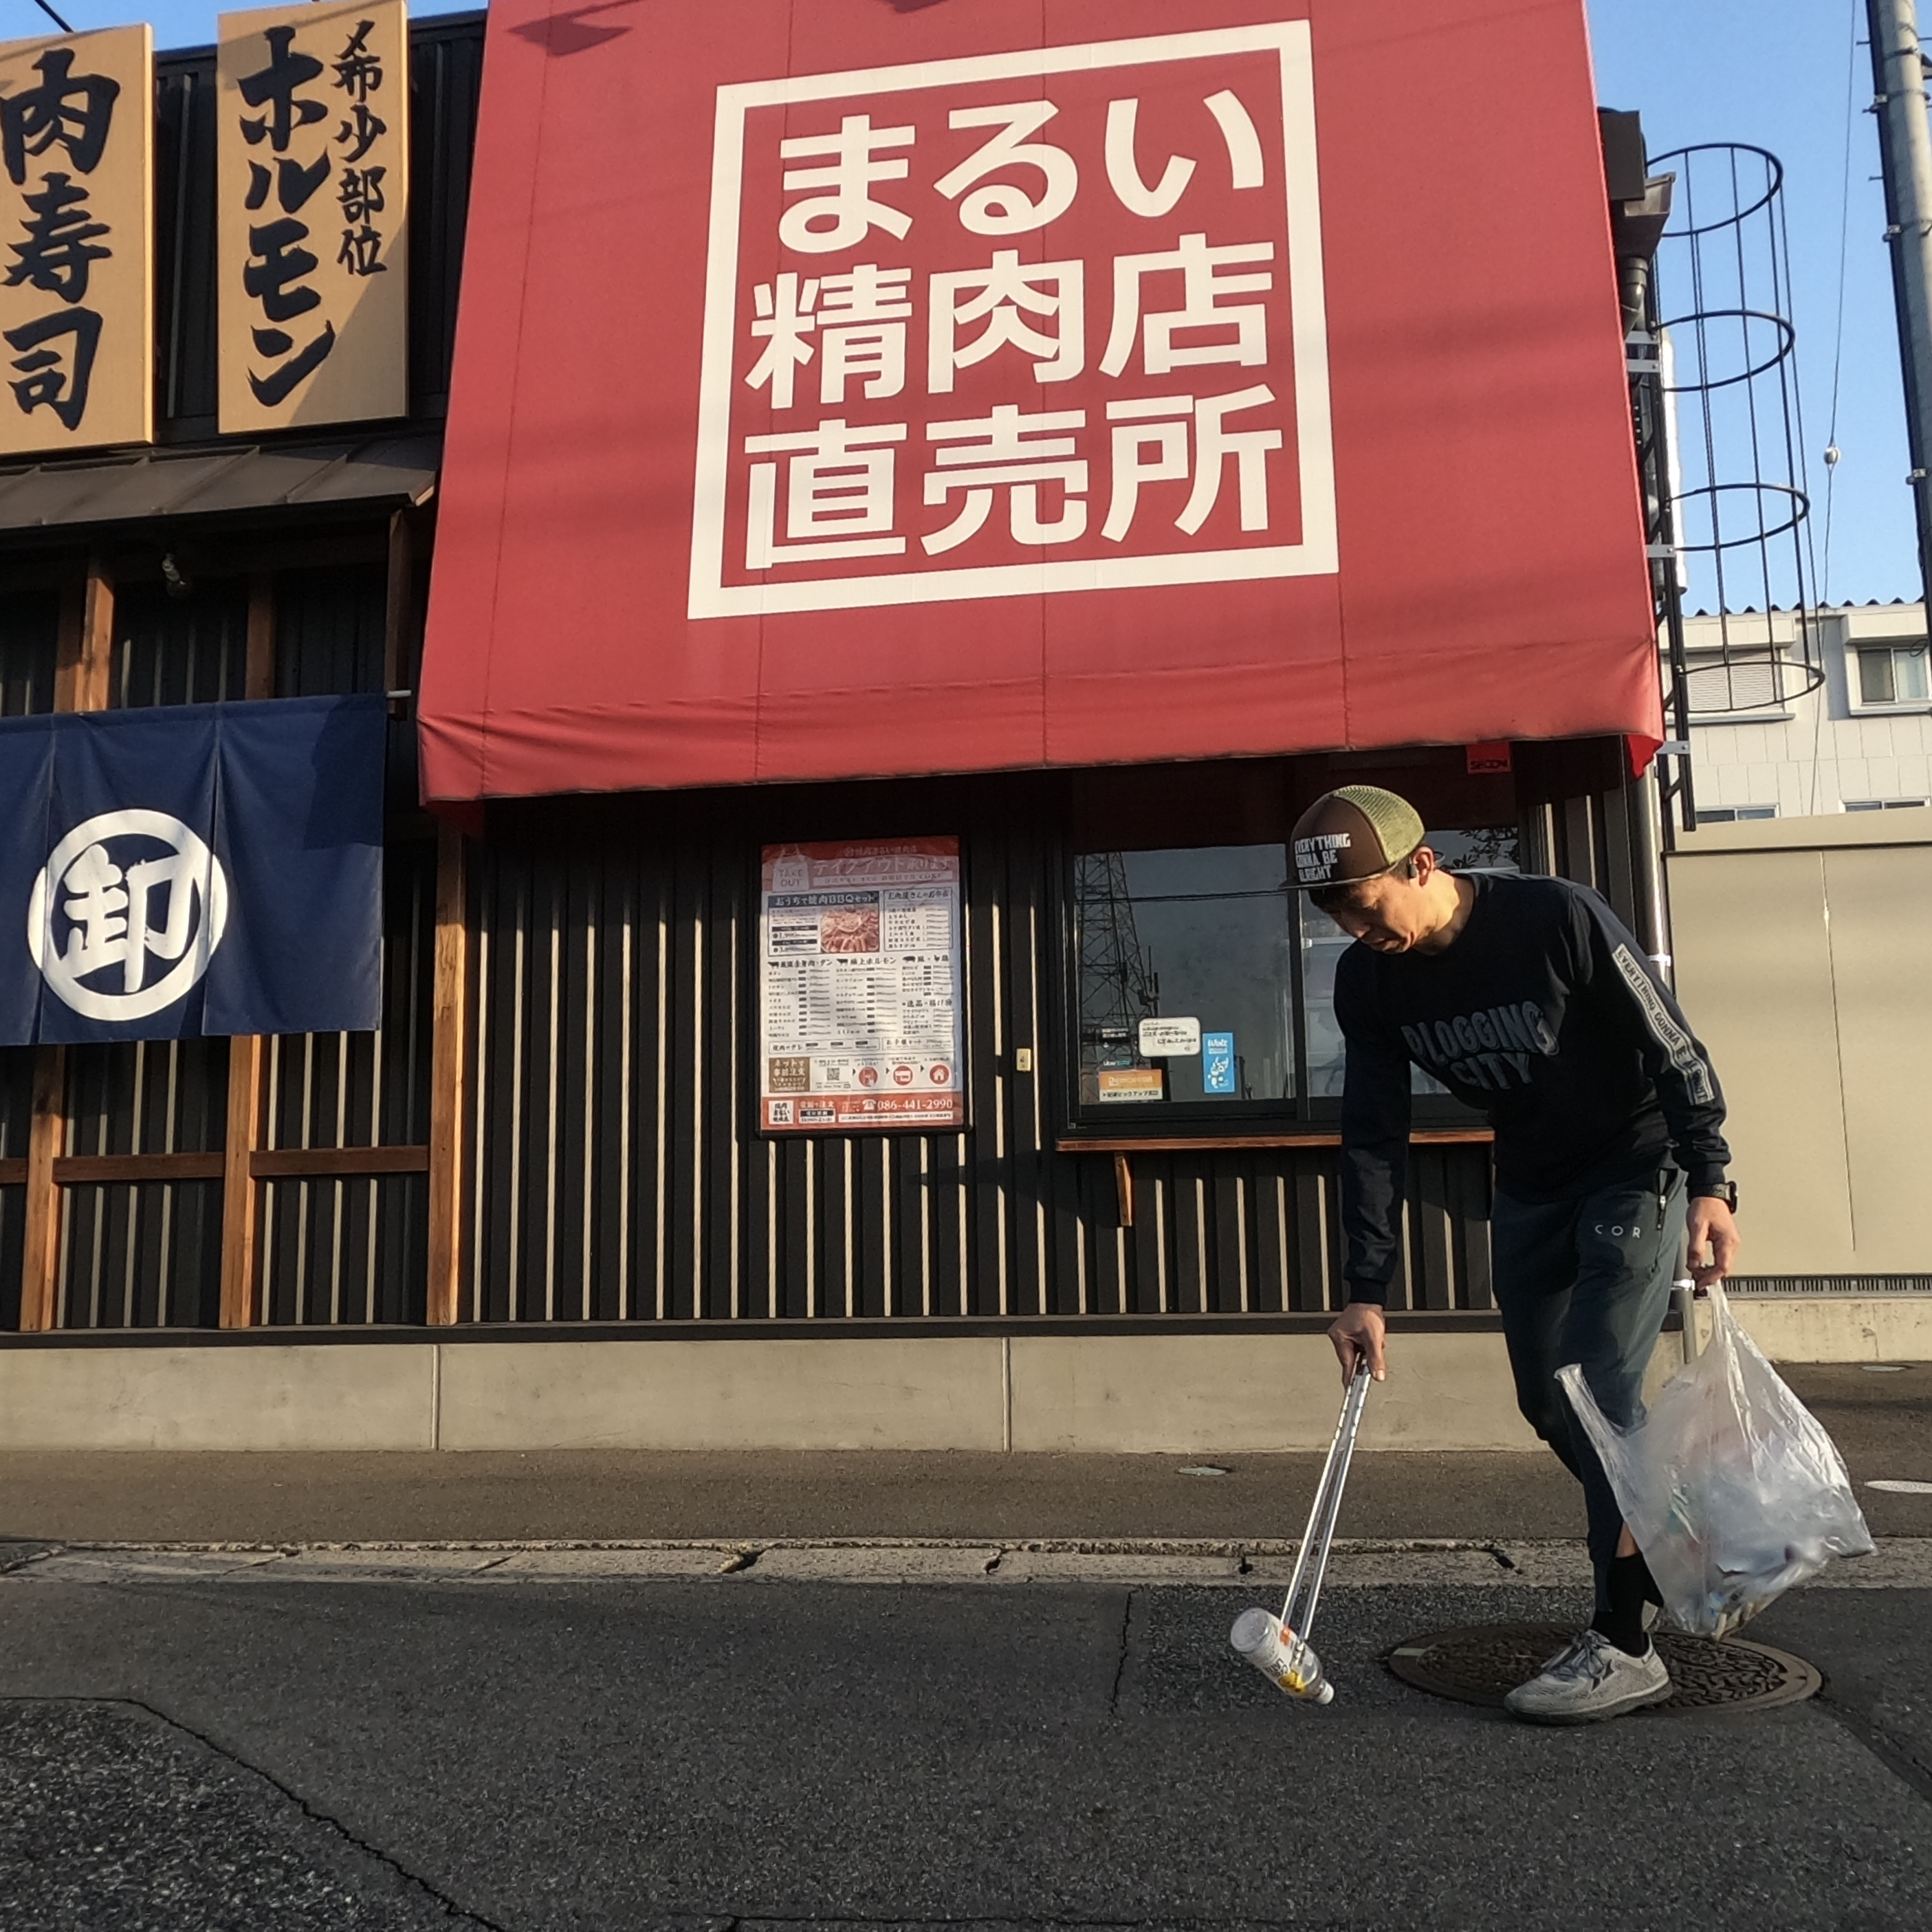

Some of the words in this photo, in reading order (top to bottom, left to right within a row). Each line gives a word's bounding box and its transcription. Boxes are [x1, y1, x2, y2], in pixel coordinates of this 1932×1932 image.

[238, 25, 336, 407] ホルモン
[331, 19, 387, 276] 希少部位
[778, 89, 1264, 253] まるい
[0, 48, 120, 431] 肉寿司
[745, 233, 1275, 409] 精肉店
[745, 384, 1283, 569] 直売所
[50, 840, 203, 994] 卸
[780, 879, 800, 887] OUT
[1321, 849, 1338, 864] BE
[877, 1099, 953, 1111] 086-441-2990
[1400, 1000, 1559, 1067] PLOGGING
[1449, 1053, 1533, 1090] CITY
[1594, 1225, 1641, 1238] COR
